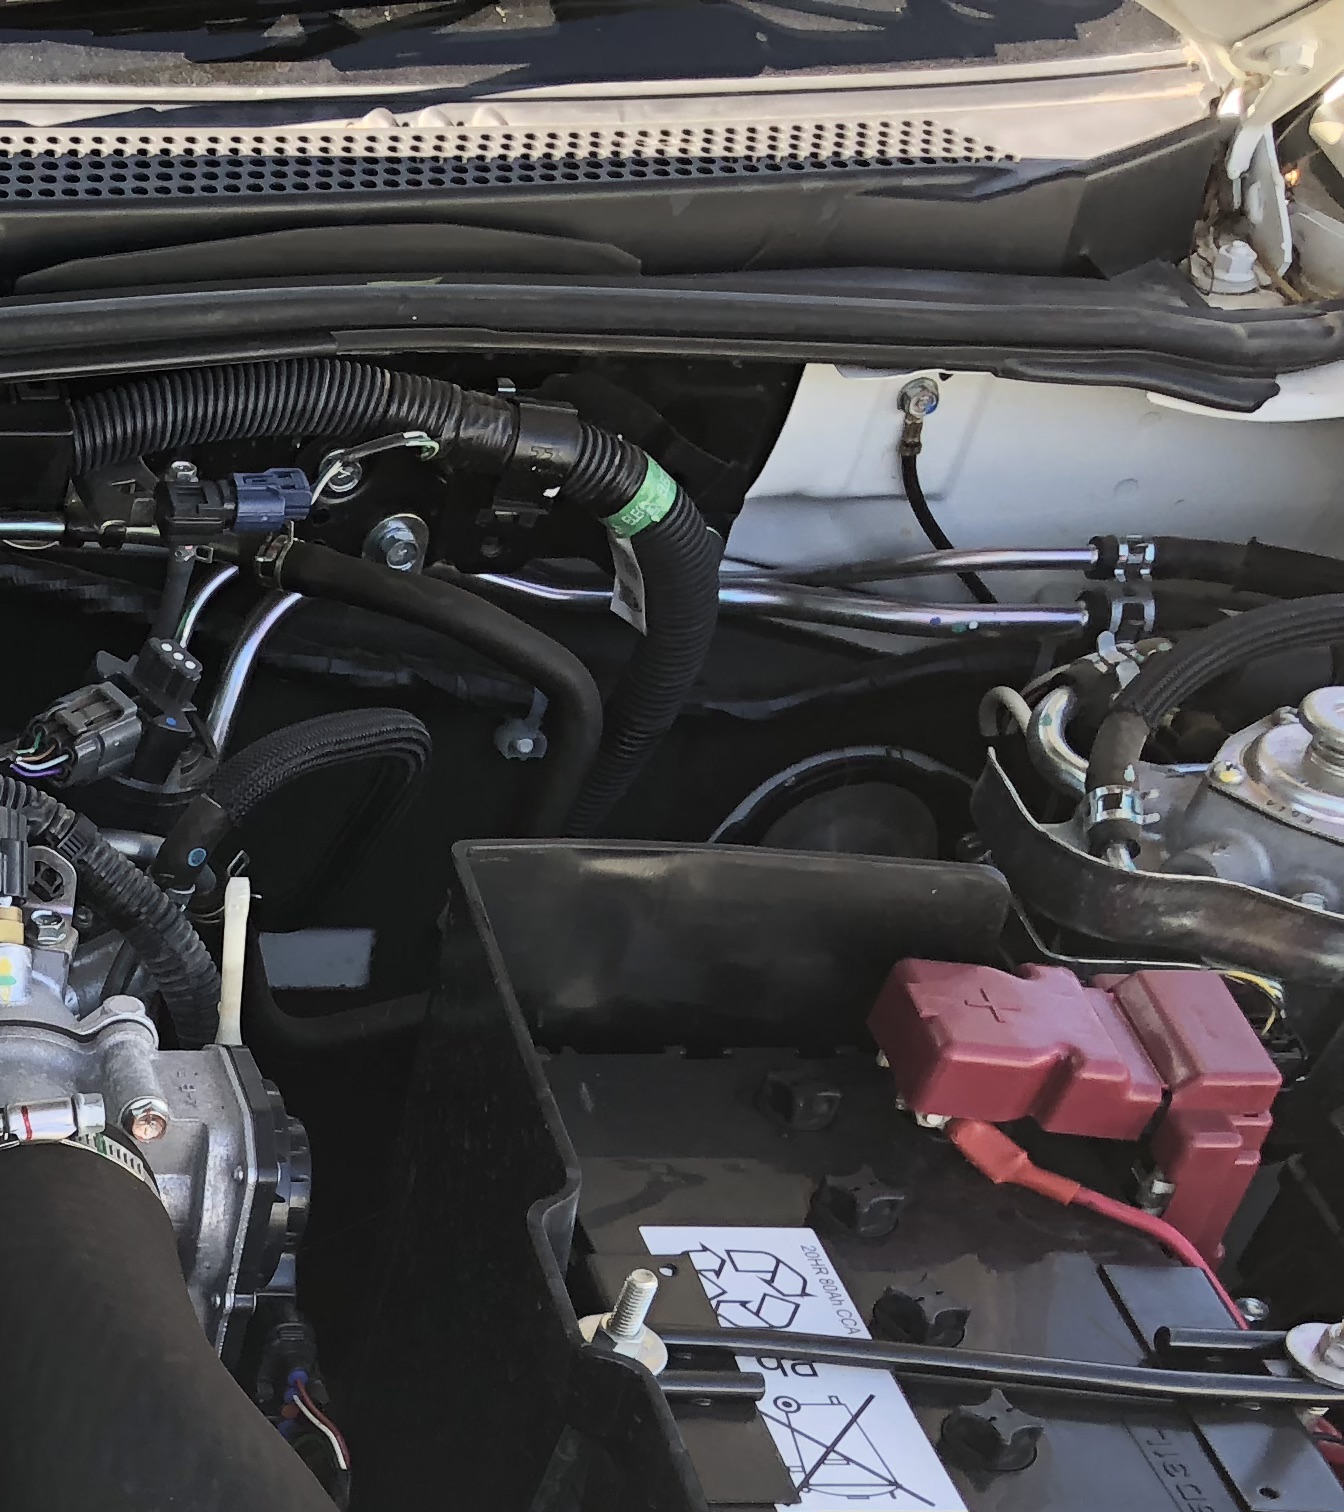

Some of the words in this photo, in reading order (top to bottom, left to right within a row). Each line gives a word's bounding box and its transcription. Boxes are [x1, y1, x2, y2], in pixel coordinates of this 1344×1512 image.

[799, 1244, 829, 1275] 20HR
[818, 1278, 843, 1306] 80Ah
[836, 1309, 862, 1335] CCA
